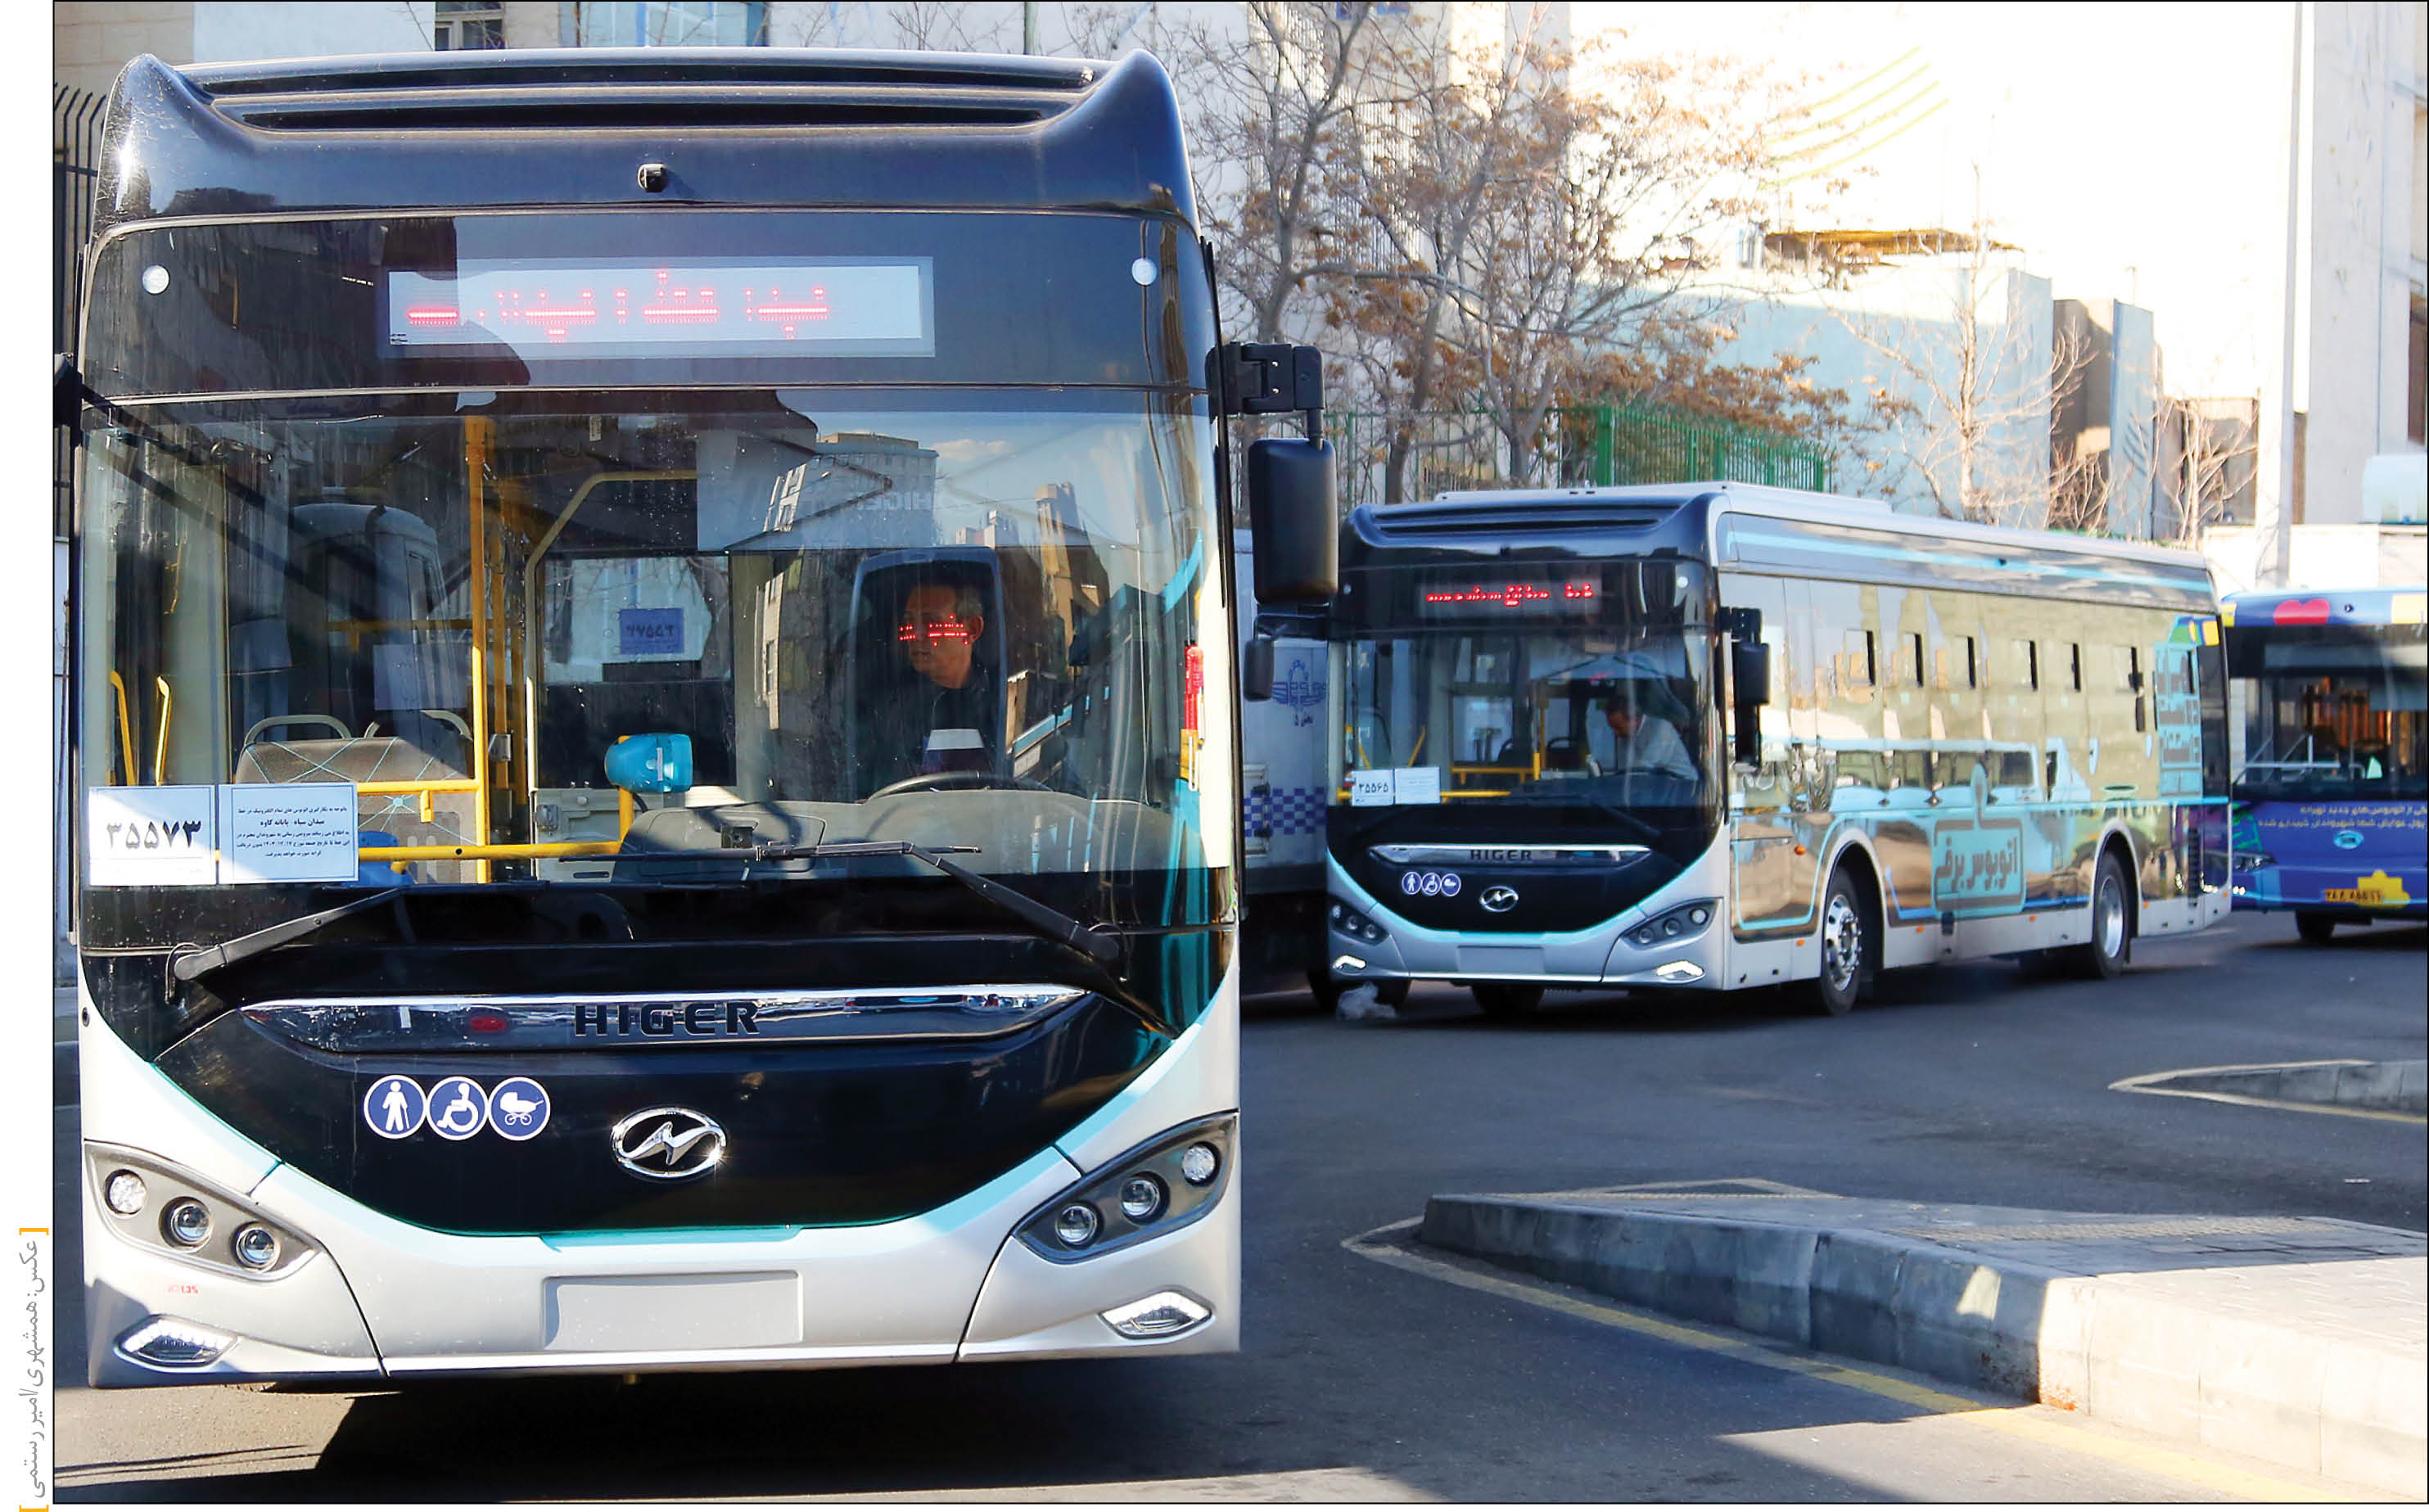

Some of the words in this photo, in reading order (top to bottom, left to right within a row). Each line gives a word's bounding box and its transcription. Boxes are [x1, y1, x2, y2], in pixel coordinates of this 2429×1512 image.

[106, 819, 202, 849] ۳۵۵۷۳
[1470, 849, 1533, 860] HIGER
[1966, 836, 2018, 892] اتوبوس
[575, 1001, 761, 1036] HIGER
